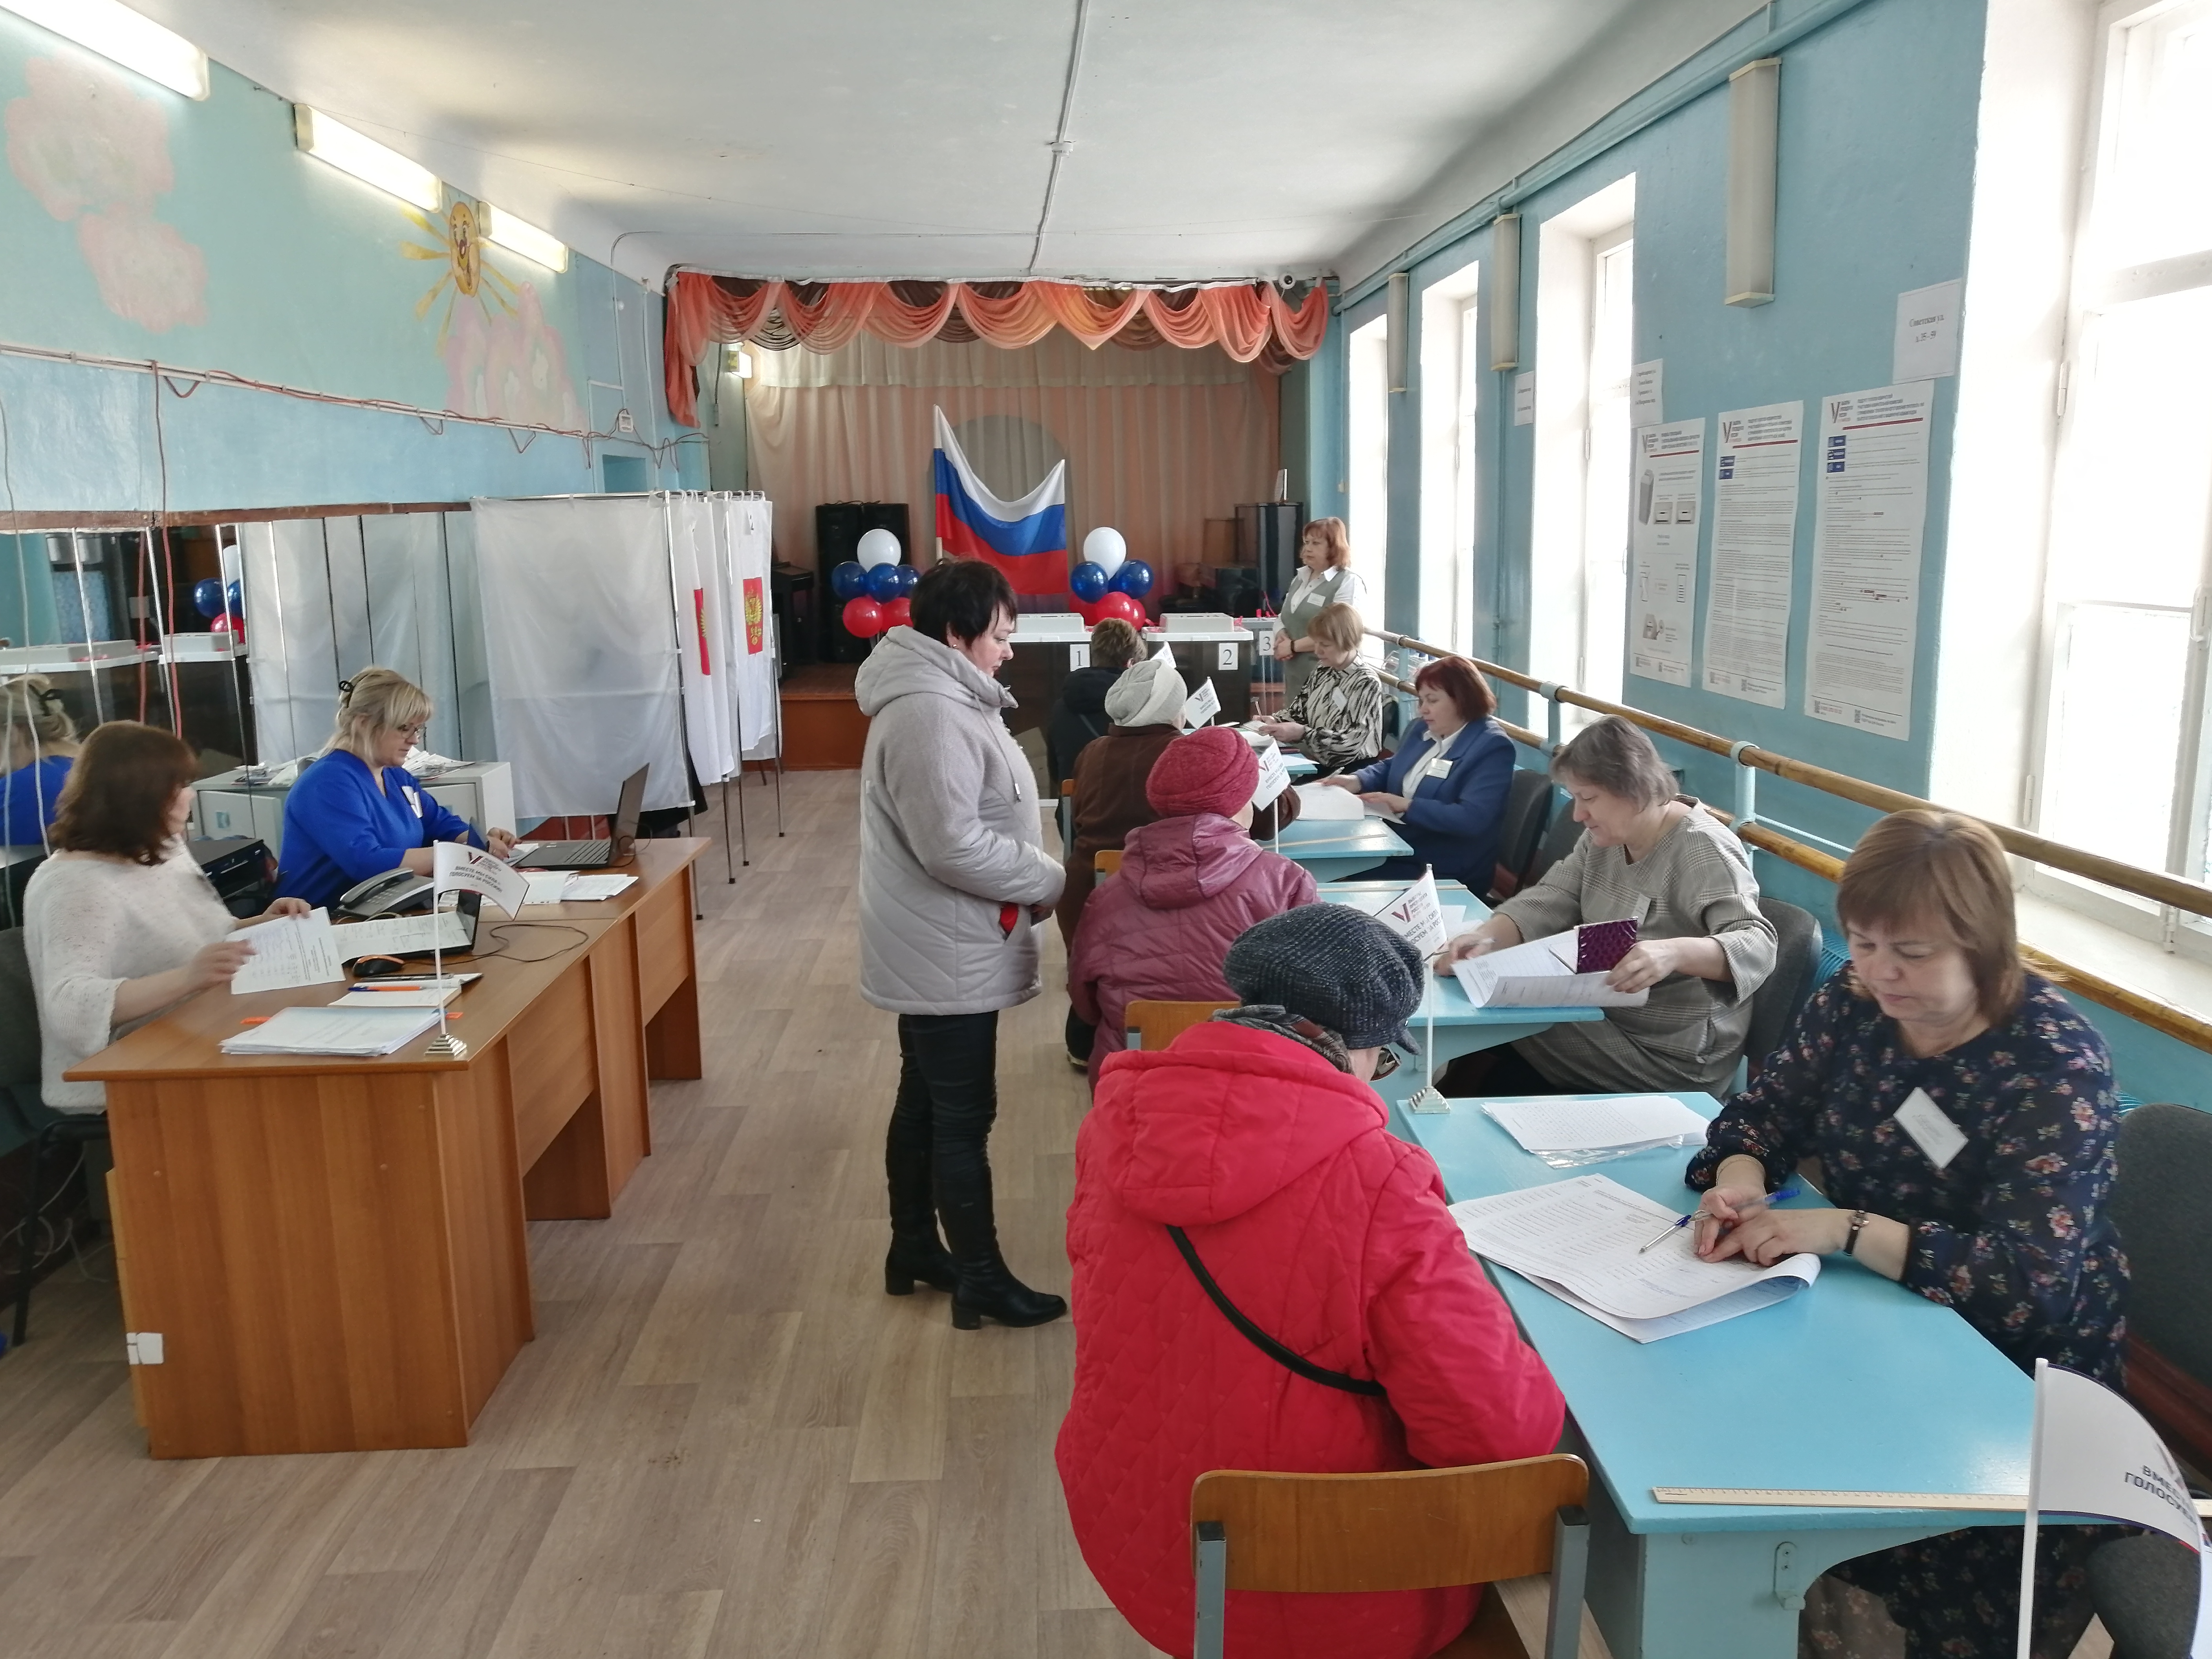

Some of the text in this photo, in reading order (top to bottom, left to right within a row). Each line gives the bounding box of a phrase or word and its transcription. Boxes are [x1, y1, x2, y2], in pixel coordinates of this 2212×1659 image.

[1263, 636, 1271, 651] 3
[1076, 650, 1082, 667] 1
[1223, 649, 1233, 665] 2
[1404, 924, 1422, 938] МЕСТЕ
[1410, 929, 1428, 945] ОСУЕМ
